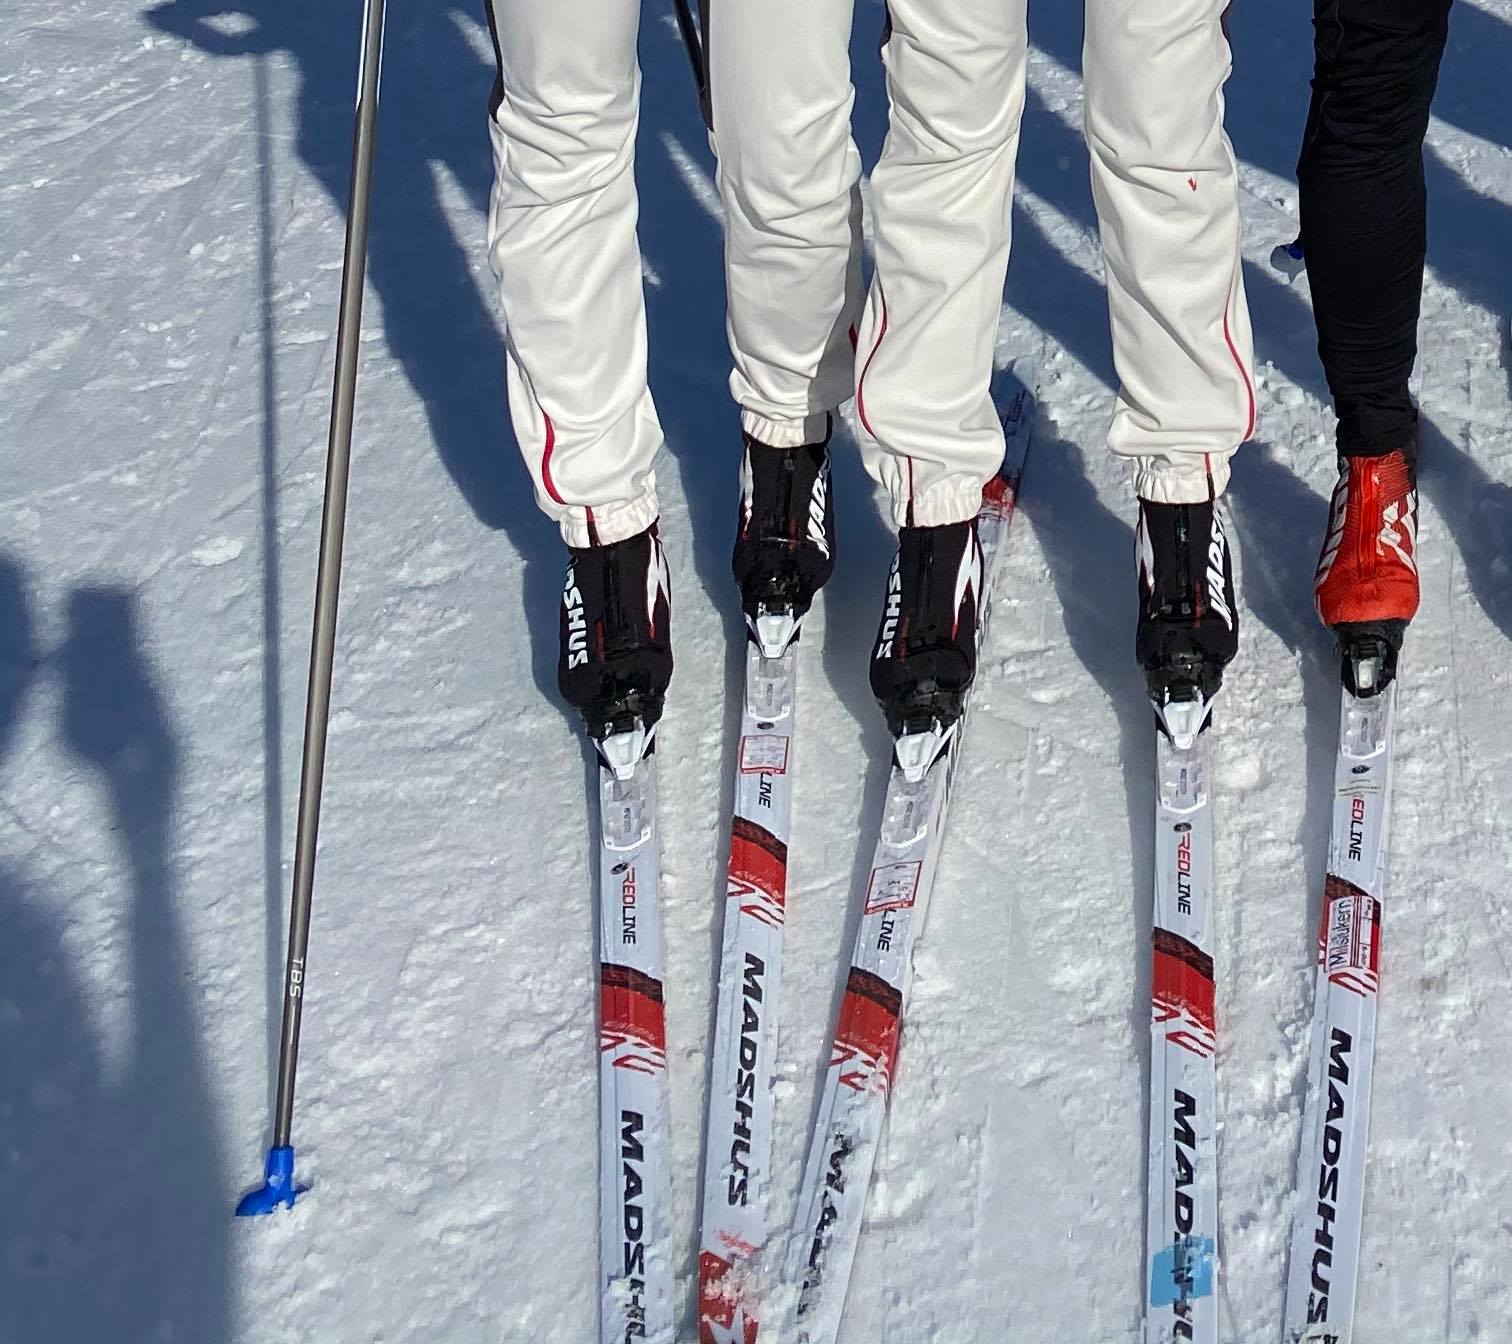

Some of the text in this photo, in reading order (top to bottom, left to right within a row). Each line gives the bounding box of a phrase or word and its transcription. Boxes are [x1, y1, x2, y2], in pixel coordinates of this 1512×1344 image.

[623, 868, 637, 945] REDLINE
[1175, 832, 1192, 915] REDLINE
[728, 952, 766, 1207] MADSHUS
[1306, 1027, 1352, 1325] MADSHUS
